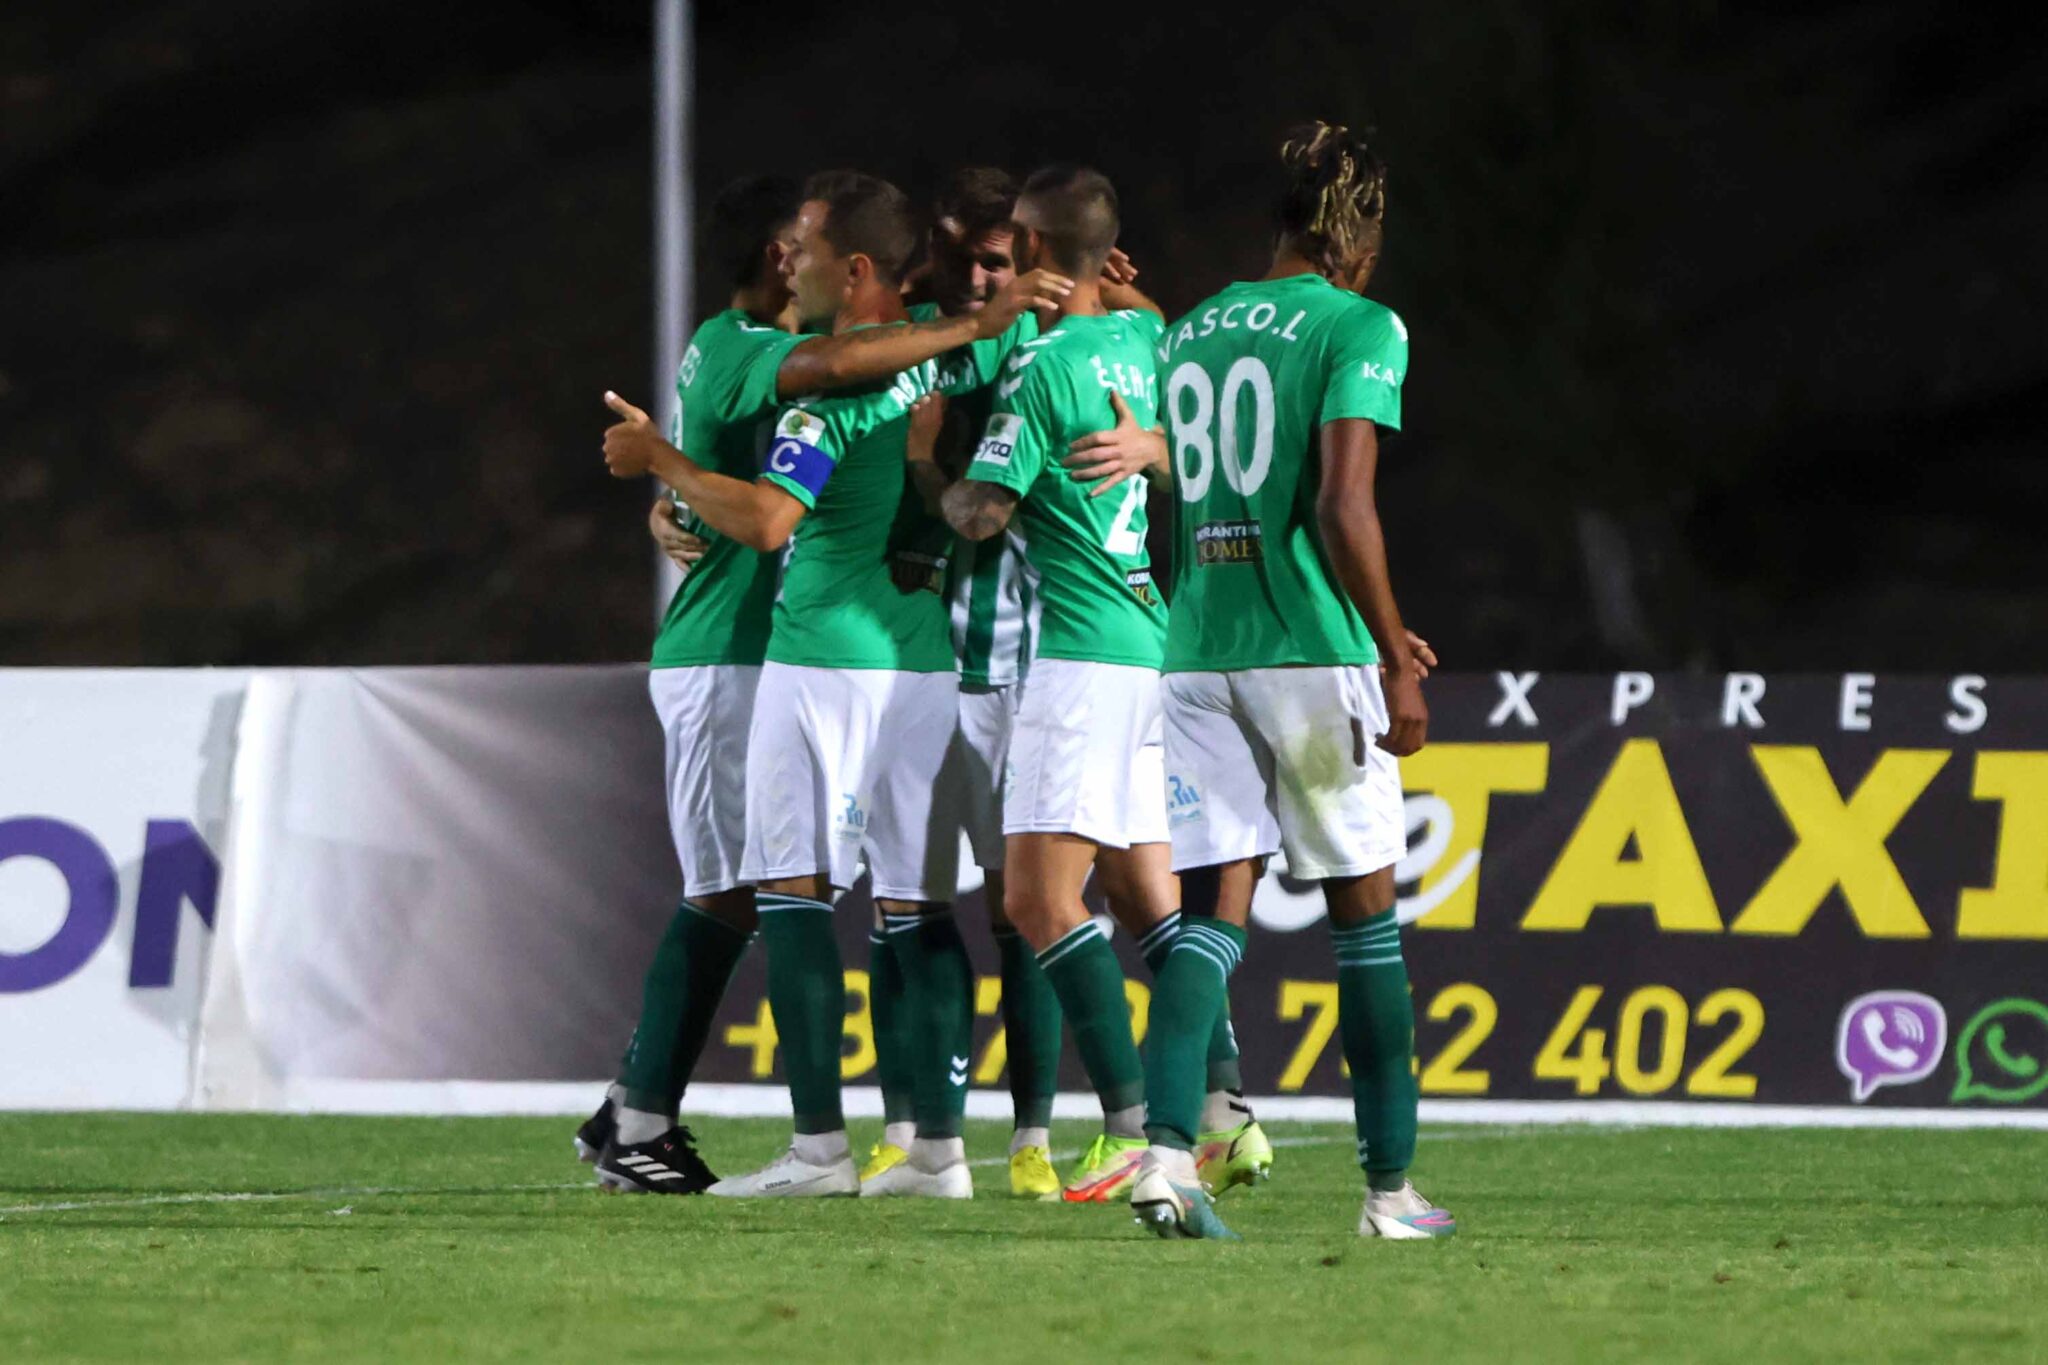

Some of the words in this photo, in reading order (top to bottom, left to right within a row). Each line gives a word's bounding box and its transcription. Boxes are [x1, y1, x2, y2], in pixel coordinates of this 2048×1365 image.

[1158, 303, 1306, 363] VASCO.L
[771, 440, 802, 474] C
[1167, 356, 1275, 503] 80
[1277, 979, 1499, 1094] 72
[1532, 984, 1766, 1098] 402
